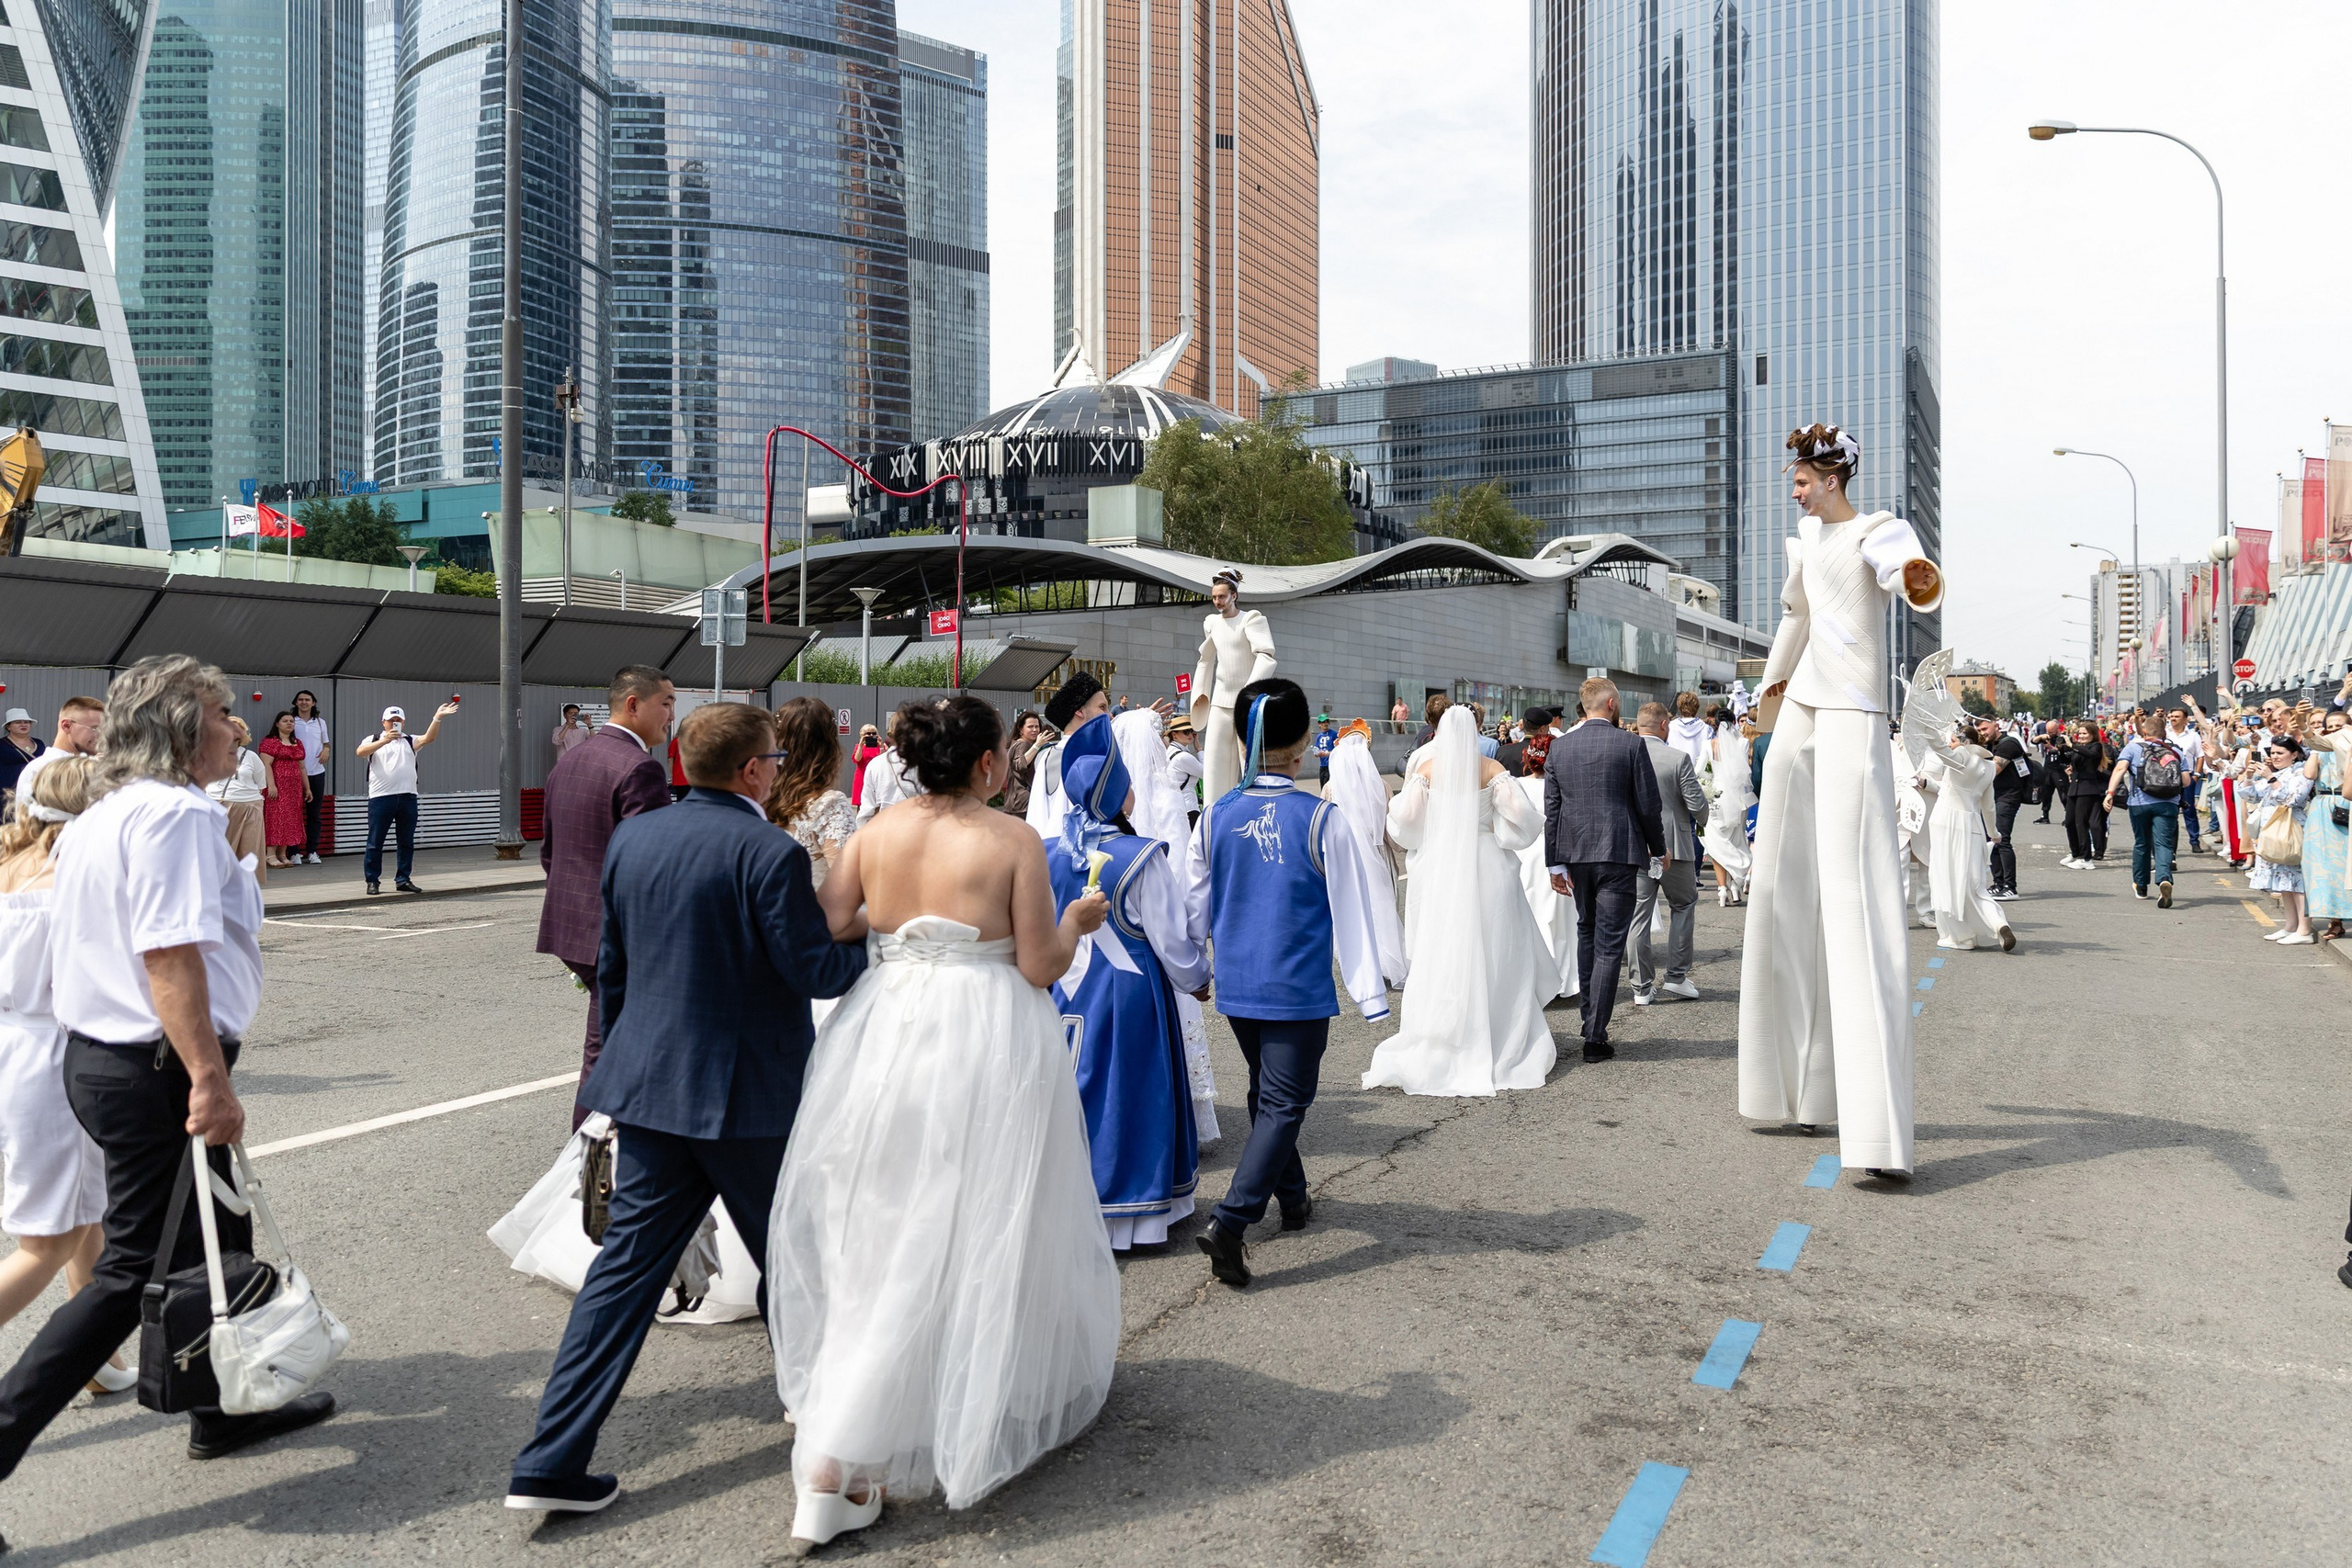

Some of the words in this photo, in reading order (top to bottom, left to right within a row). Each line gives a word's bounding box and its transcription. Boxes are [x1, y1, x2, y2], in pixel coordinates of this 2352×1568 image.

[889, 452, 918, 479] XIX
[937, 445, 986, 473] XVIII
[1007, 442, 1058, 468] XVII
[1090, 441, 1136, 467] XVI
[339, 469, 380, 496] Сити
[640, 460, 695, 493] Сити
[2234, 665, 2256, 673] STOP
